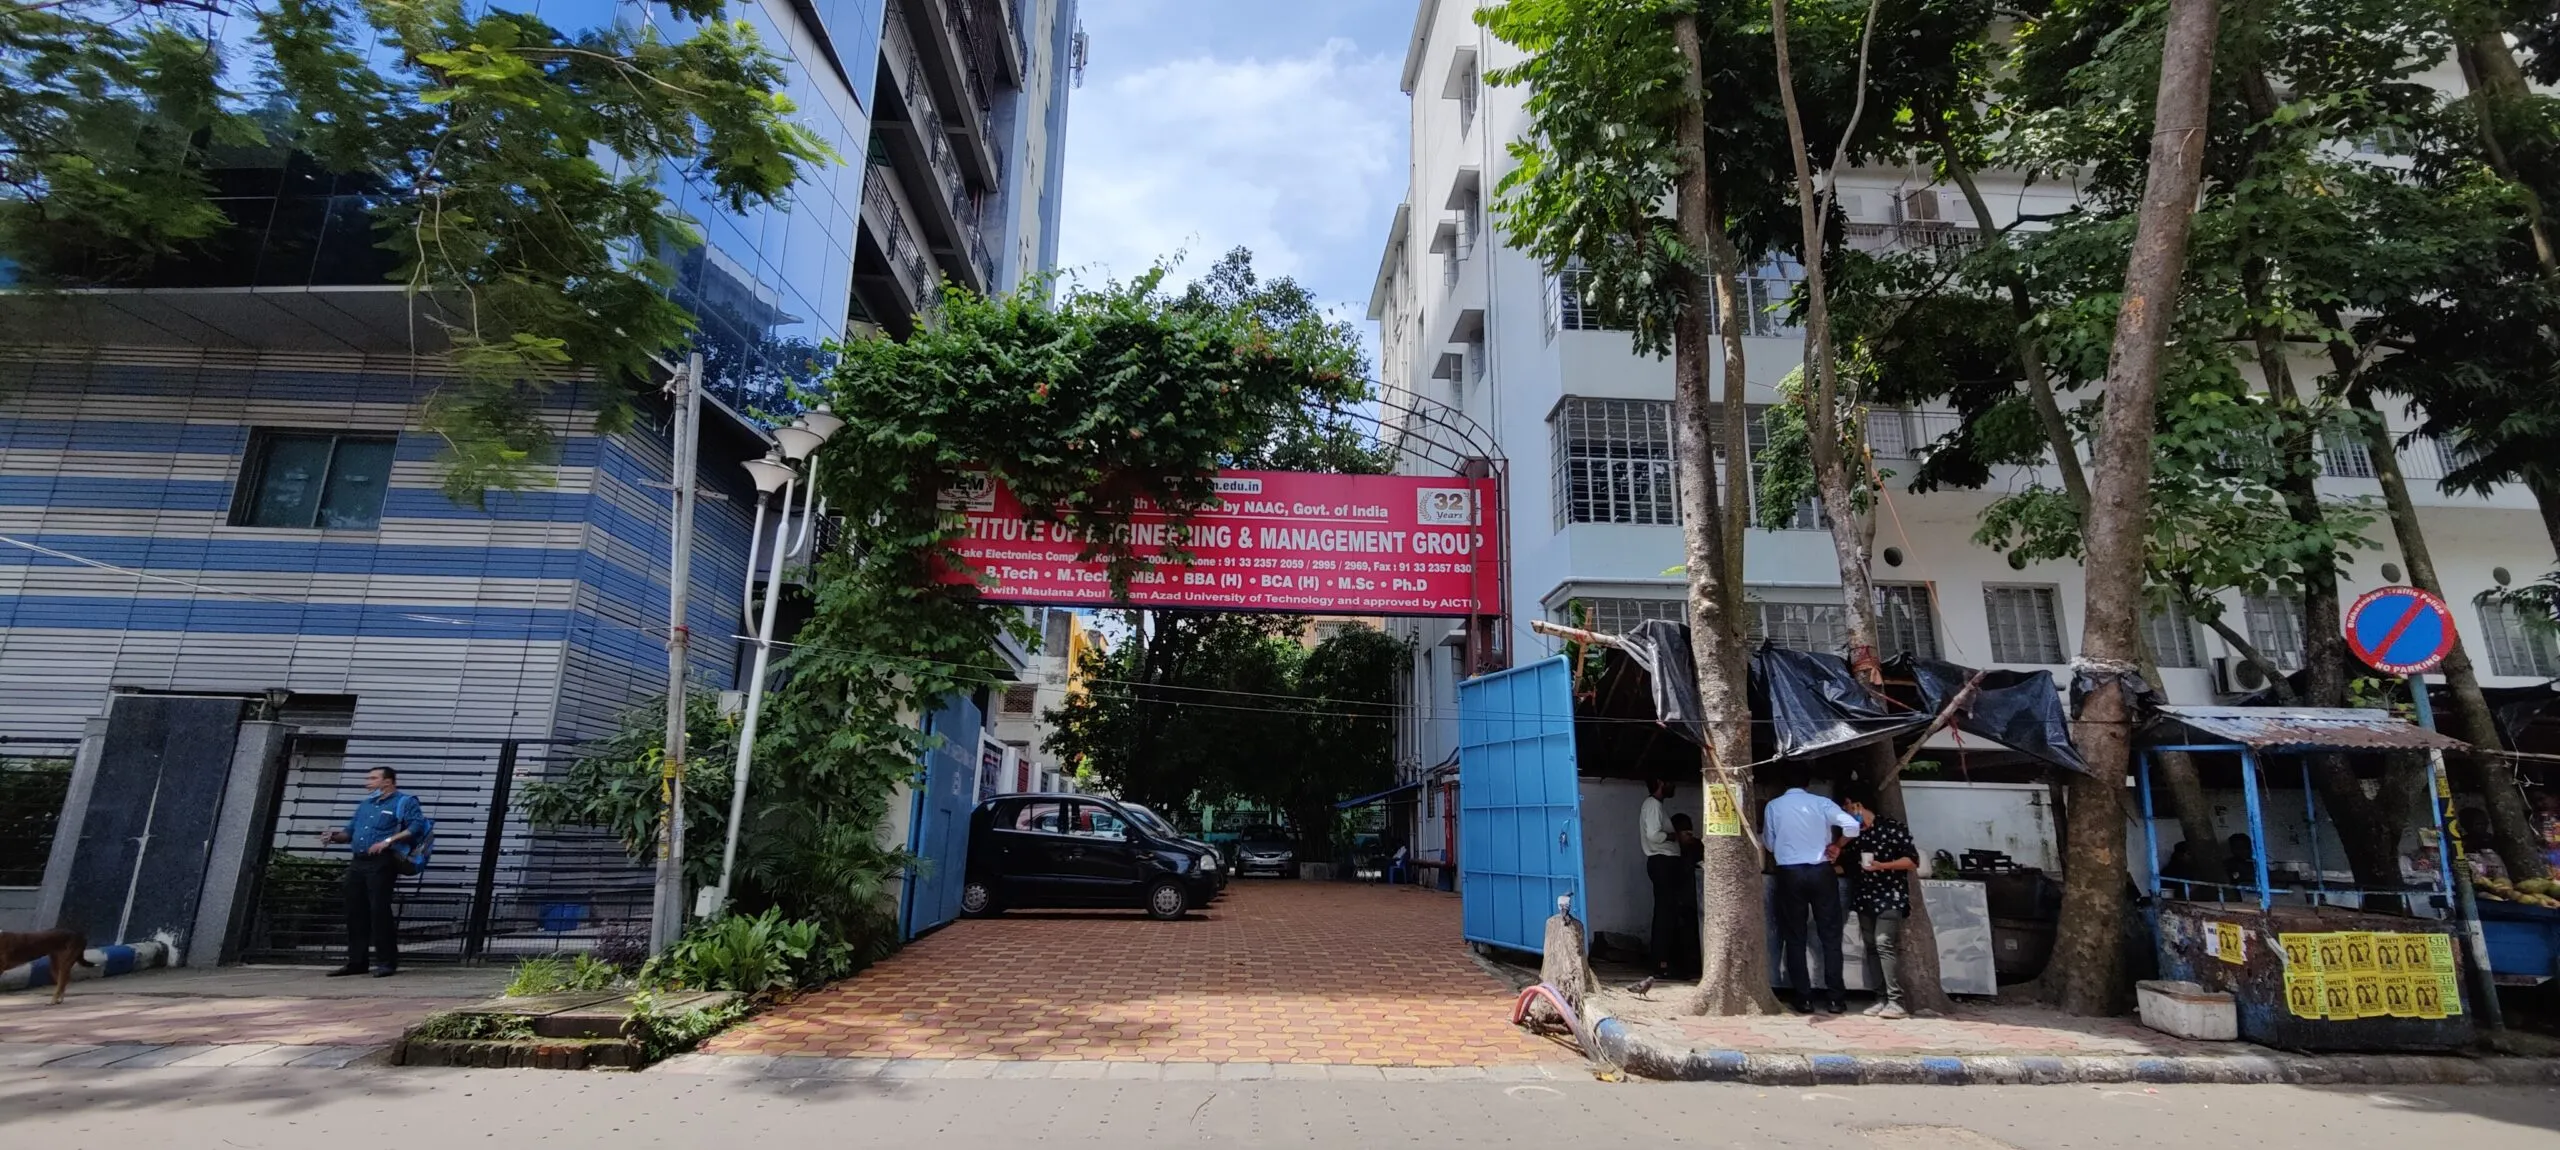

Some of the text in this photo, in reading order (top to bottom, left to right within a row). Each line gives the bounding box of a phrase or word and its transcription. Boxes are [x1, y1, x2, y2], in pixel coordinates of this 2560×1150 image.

[1222, 501, 1239, 515] by
[1244, 502, 1288, 516] NAAC,
[1293, 503, 1328, 516] Govt.
[1336, 505, 1349, 517] of
[1353, 506, 1389, 518] India
[1434, 493, 1463, 511] 32
[1436, 511, 1463, 520] Years
[1238, 527, 1253, 550] &
[1260, 527, 1406, 553] MANAGEMENT
[1413, 532, 1484, 555] GROUP
[958, 548, 983, 558] Lake
[985, 549, 1043, 561] Electronics
[1224, 558, 1237, 567] 91
[1239, 558, 1252, 568] 33
[1254, 559, 1278, 569] 2357
[1280, 560, 1305, 571] 2059
[1312, 561, 1336, 571] 2995
[1374, 562, 1391, 572] Fax
[1399, 564, 1411, 573] 91
[1413, 563, 1426, 573] 33
[1428, 563, 1451, 574] 2357
[986, 565, 1039, 580] B.Tech
[1131, 571, 1166, 585] MBA
[1184, 573, 1216, 586] BBA
[1221, 573, 1243, 588] (H)
[1261, 575, 1293, 588] BCA
[1298, 575, 1320, 591] (H)
[1338, 577, 1375, 591] M.Sc
[1393, 578, 1428, 591] Ph.D
[993, 586, 1018, 595] with
[1022, 587, 1074, 598] Maulana
[1077, 588, 1106, 598] Abul
[1150, 591, 1182, 601] Azad
[1185, 592, 1245, 604] University
[1249, 595, 1262, 603] of
[1265, 595, 1334, 608] Technology
[1338, 597, 1360, 606] and
[1363, 598, 1419, 609] approved
[1423, 599, 1437, 609] by
[2420, 594, 2444, 615] Police
[2375, 654, 2441, 673] NO PARKING
